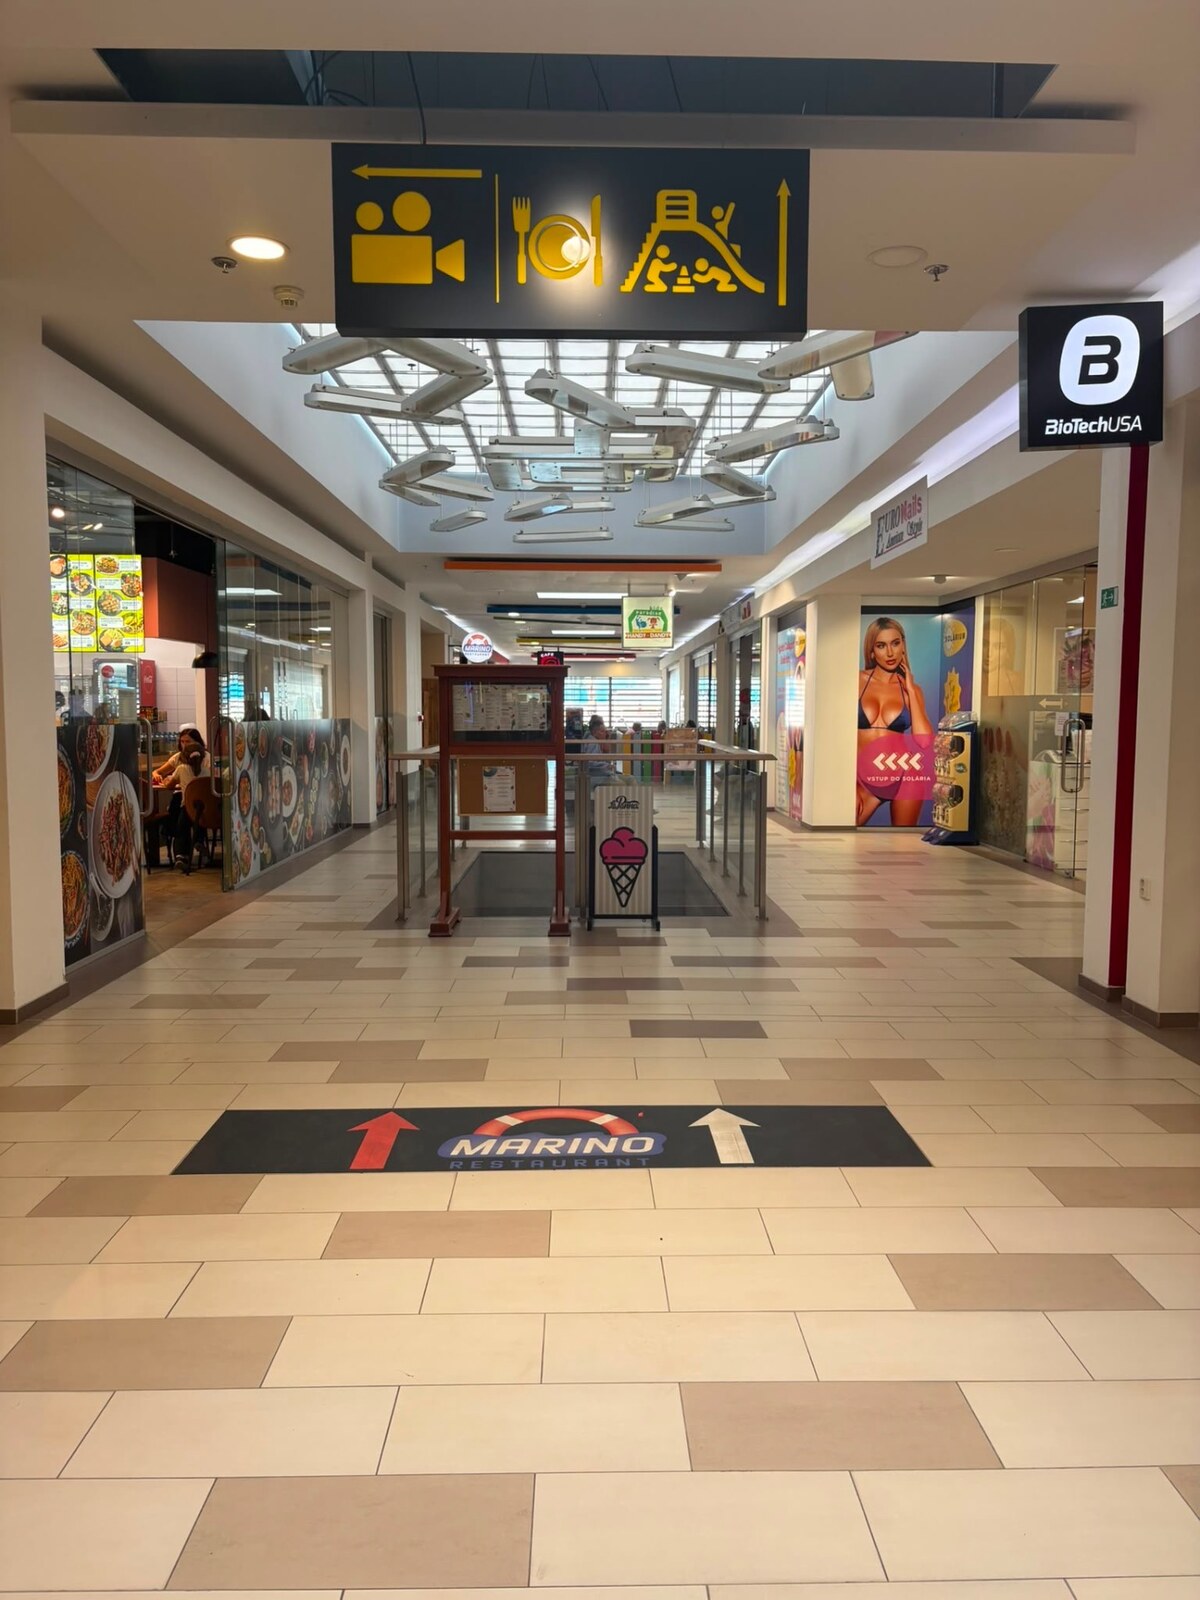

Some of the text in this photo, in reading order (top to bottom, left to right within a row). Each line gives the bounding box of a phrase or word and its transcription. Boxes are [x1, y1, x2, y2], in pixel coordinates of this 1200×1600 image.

[1045, 415, 1142, 436] BioTechUSA
[464, 644, 491, 652] MARINO
[902, 775, 931, 783] SOLÁRIA
[450, 1136, 656, 1157] MARINO
[450, 1157, 650, 1170] RESTAURANT
